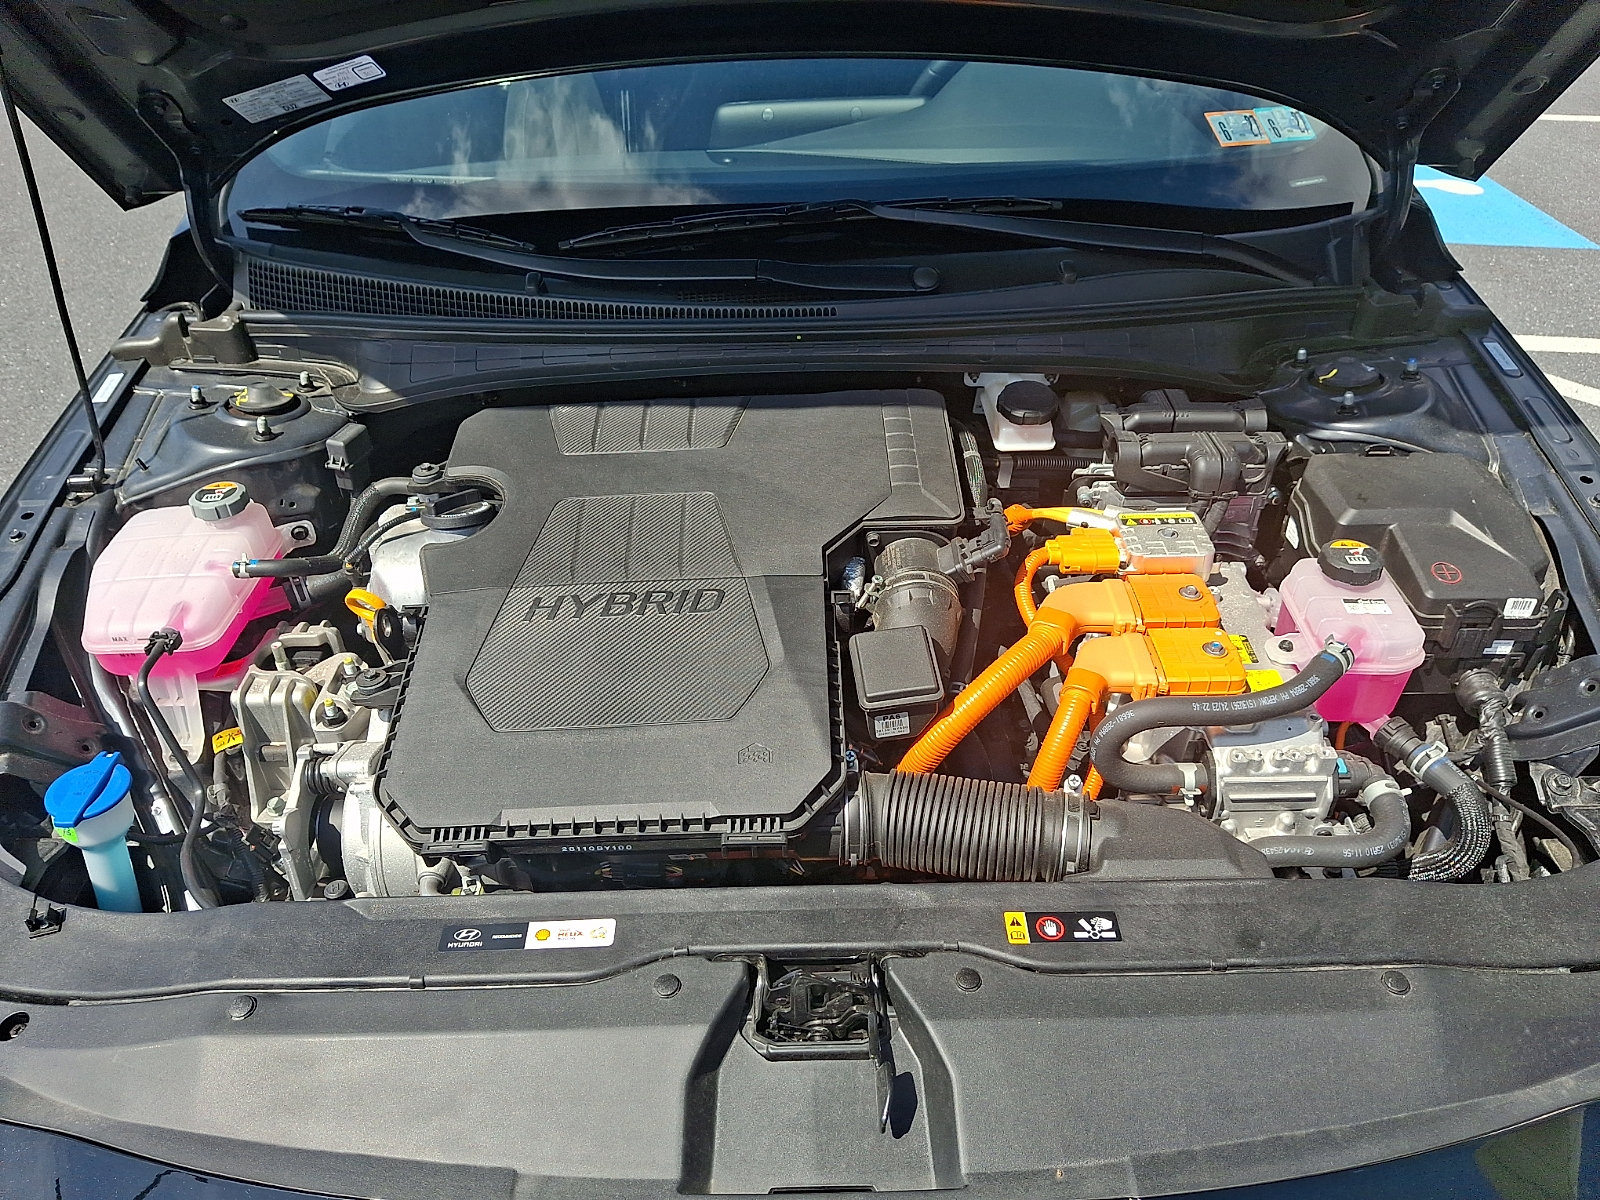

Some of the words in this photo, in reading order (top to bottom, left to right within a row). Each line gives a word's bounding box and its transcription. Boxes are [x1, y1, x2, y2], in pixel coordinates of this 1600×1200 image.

[1218, 121, 1232, 141] 6
[1268, 119, 1282, 138] 6
[523, 588, 726, 622] HYBRID
[447, 940, 483, 948] HYUNDAI
